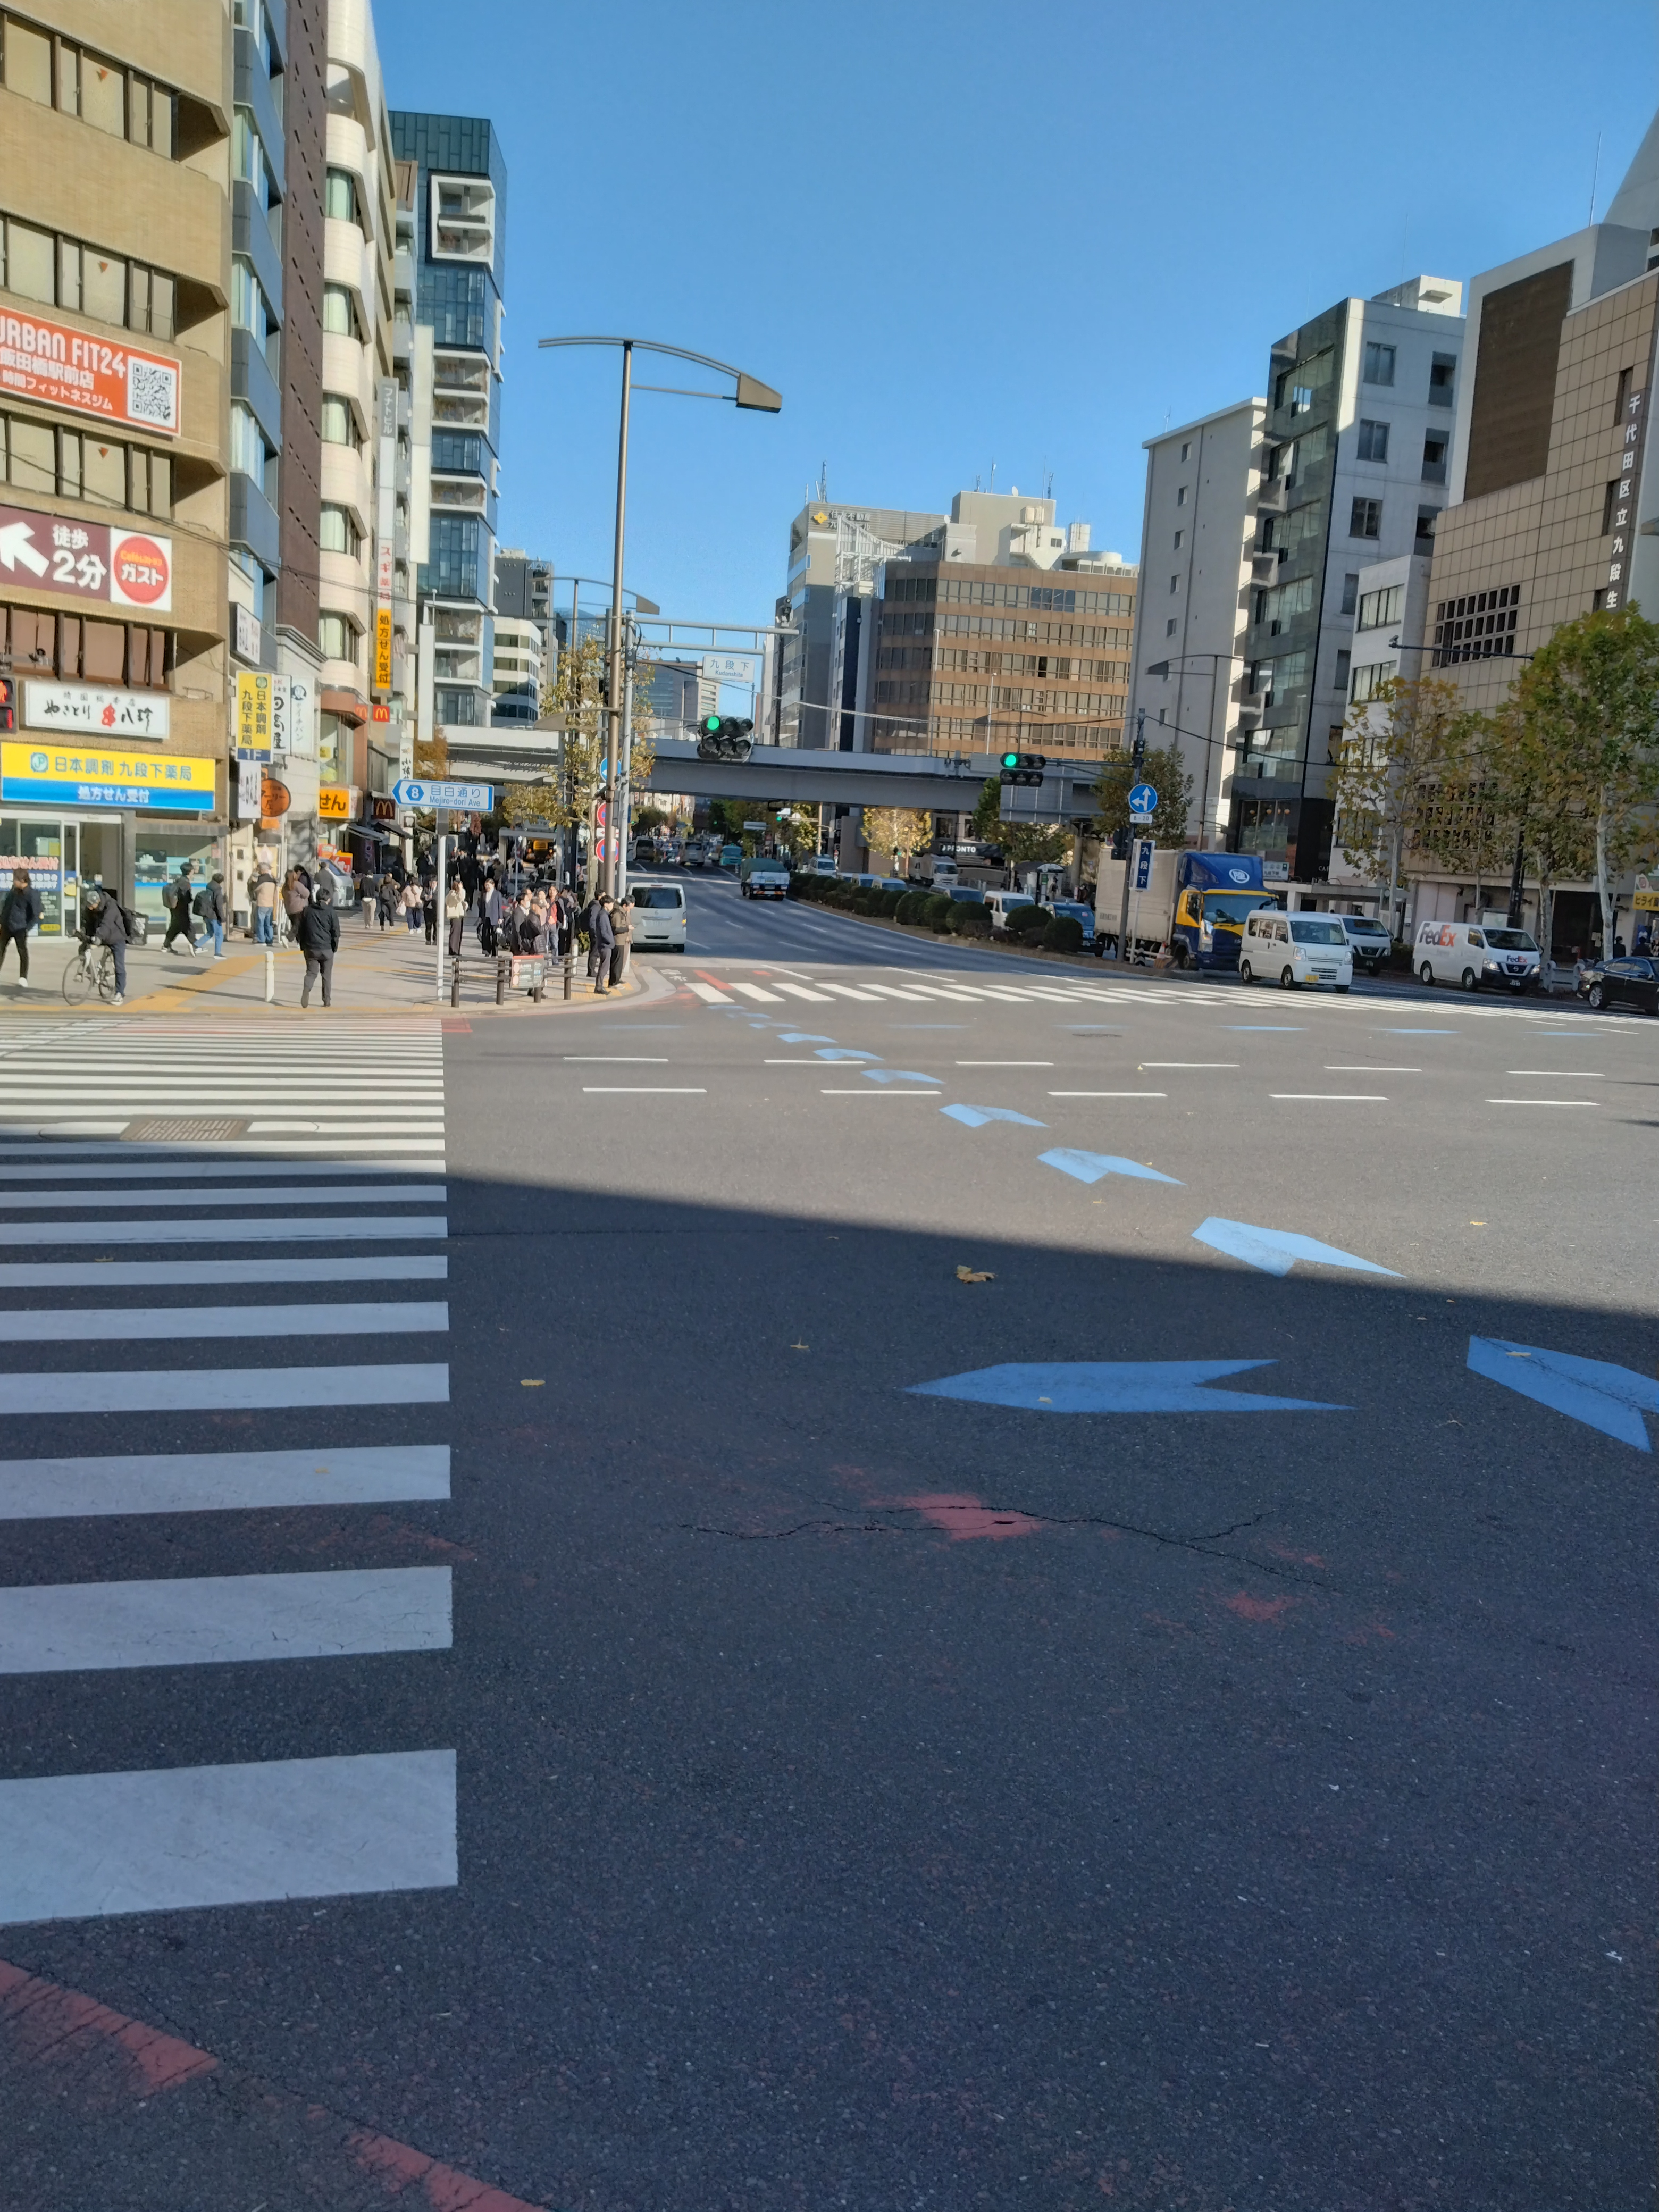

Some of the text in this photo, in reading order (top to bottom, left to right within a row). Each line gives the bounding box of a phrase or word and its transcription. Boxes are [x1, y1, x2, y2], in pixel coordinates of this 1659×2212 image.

[72, 338, 125, 379] FIT24
[383, 387, 393, 434] フナトビル
[52, 524, 89, 549] 徒歩
[53, 549, 107, 590] 2分
[121, 563, 164, 586] ガスト
[378, 615, 390, 683] 処方せん受付
[710, 659, 749, 671] 九段下
[241, 690, 253, 745] 九段下薬局
[256, 691, 267, 734] 日本調剤
[245, 749, 263, 760] 1F
[55, 757, 114, 776] 日本調剤
[119, 761, 192, 781] 九段下薬局
[78, 786, 150, 803] 処方せん受付
[411, 787, 419, 798] 8
[430, 796, 466, 806] Mejiro-dori
[431, 785, 480, 798] 目白通り
[1139, 846, 1149, 885] 九段下
[1419, 923, 1457, 947] FedEx
[1506, 955, 1527, 963] FedEx
